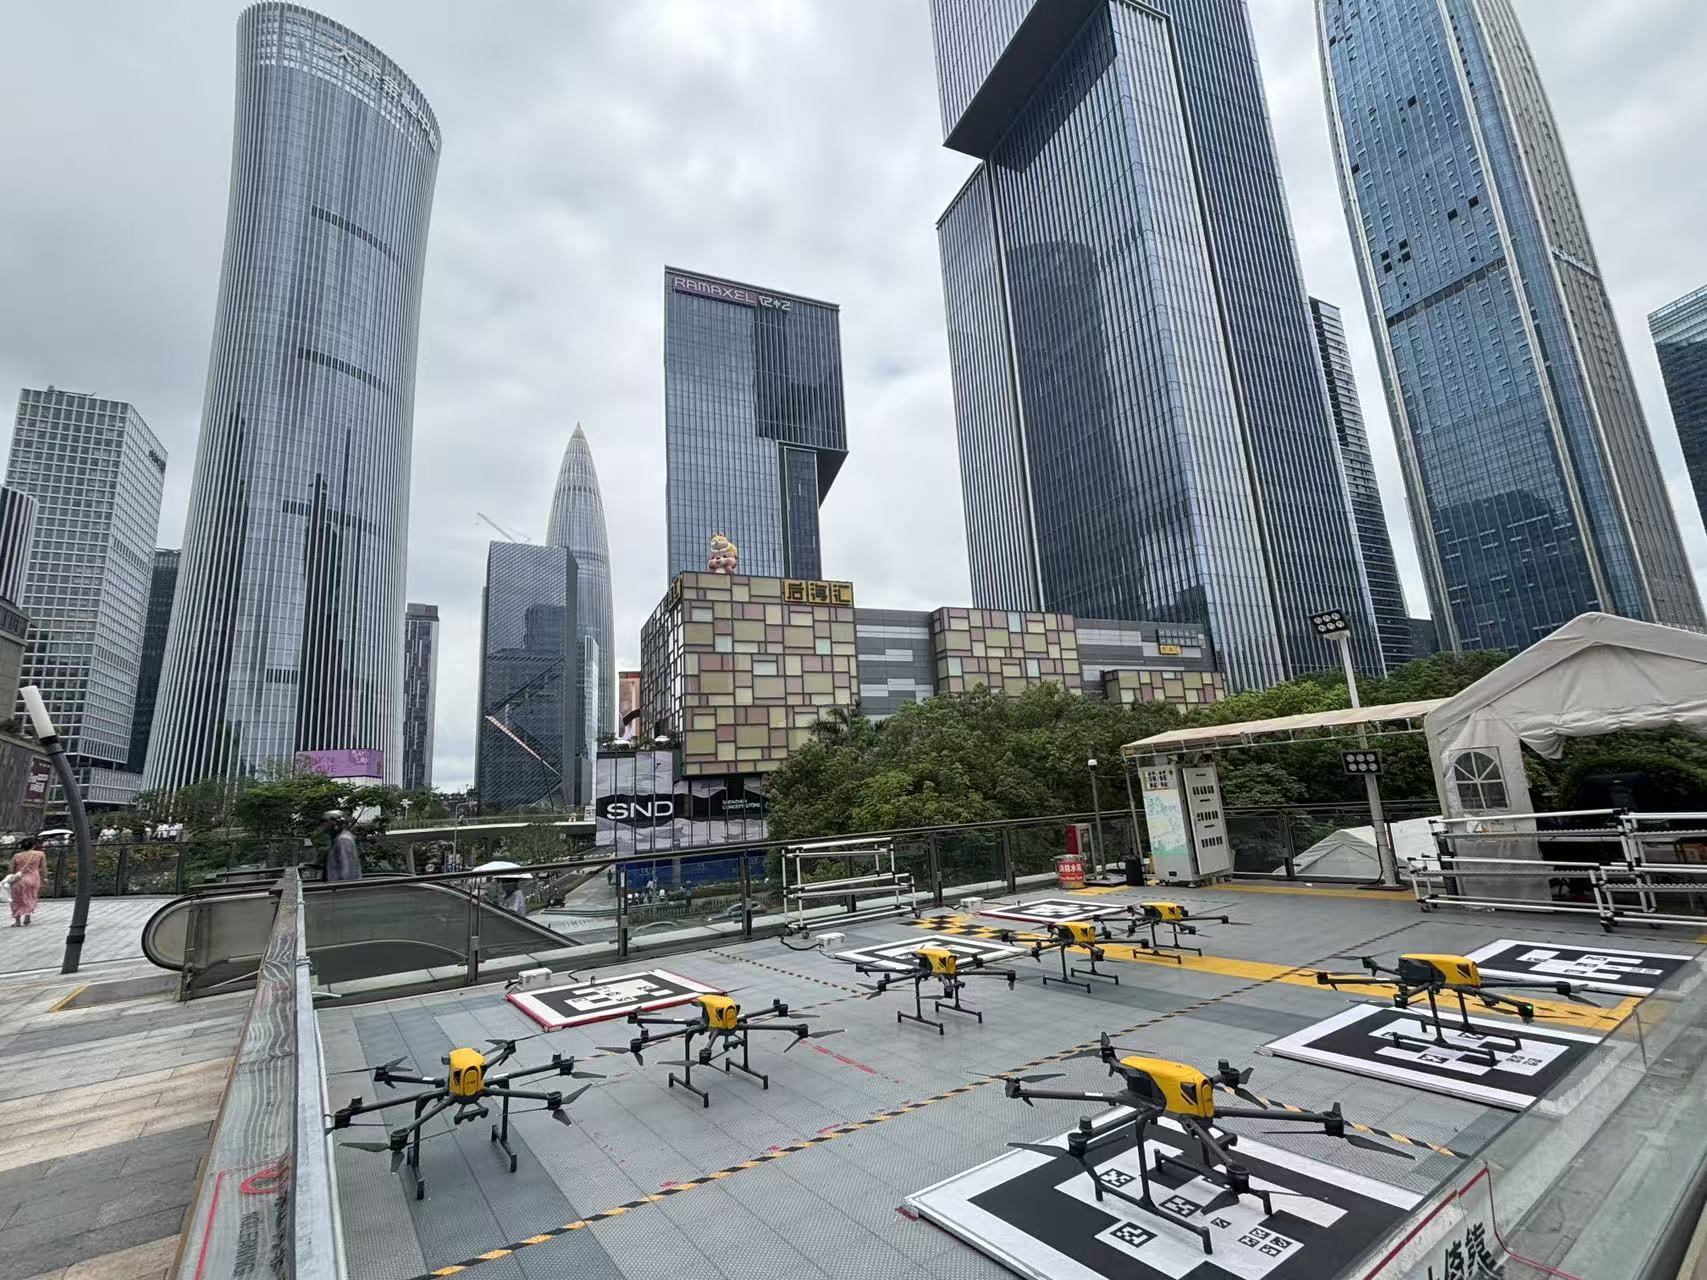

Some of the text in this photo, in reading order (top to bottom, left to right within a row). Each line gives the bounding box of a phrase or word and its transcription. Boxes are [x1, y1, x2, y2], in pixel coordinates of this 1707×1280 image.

[674, 277, 756, 304] RAMAXEL
[606, 800, 673, 819] SND
[1427, 1222, 1497, 1280] 倚靠
